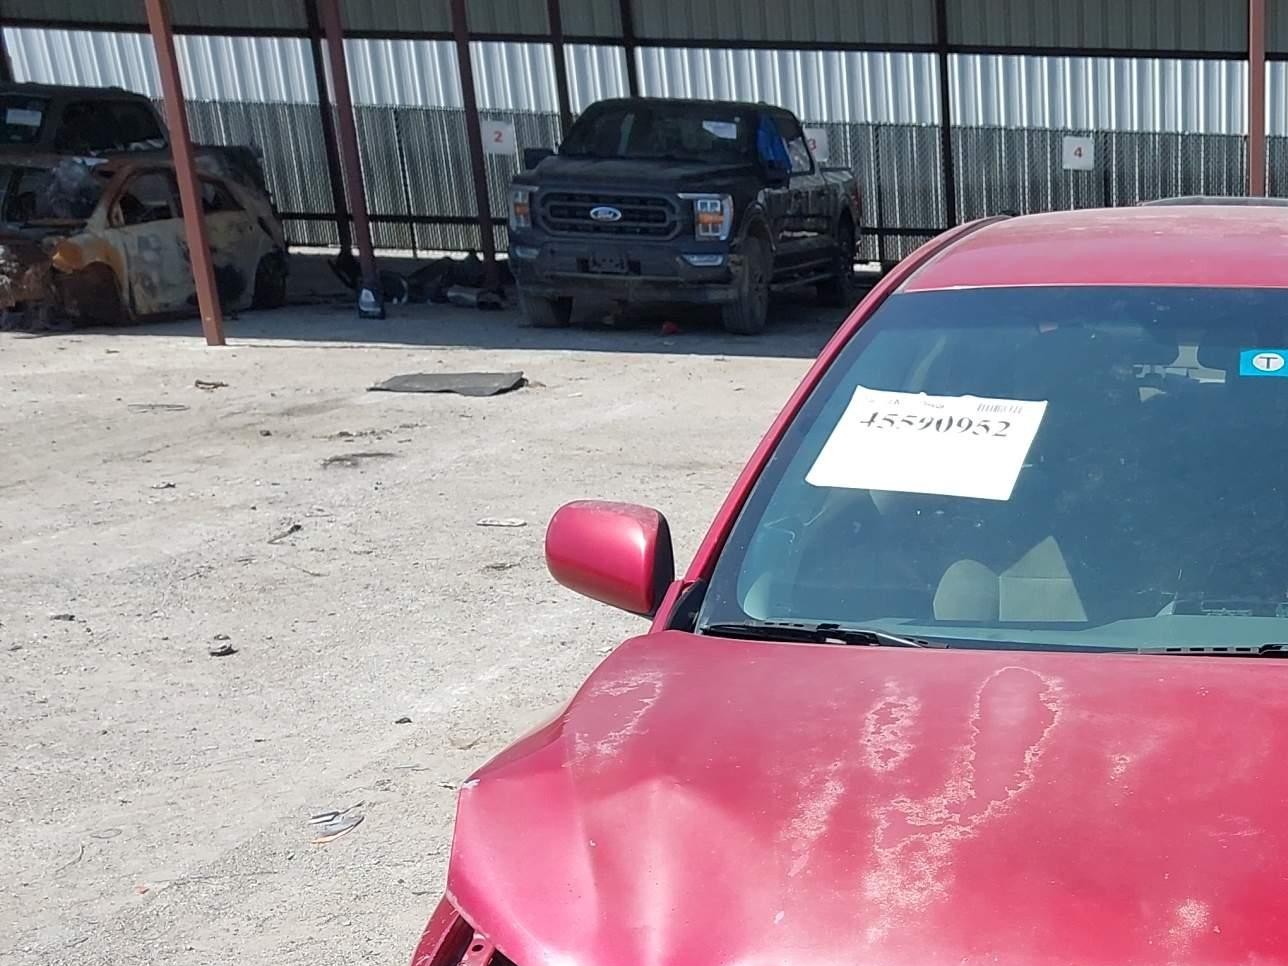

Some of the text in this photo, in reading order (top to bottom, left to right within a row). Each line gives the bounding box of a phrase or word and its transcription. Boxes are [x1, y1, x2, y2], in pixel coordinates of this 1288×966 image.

[493, 130, 504, 143] 2
[1073, 146, 1083, 158] 4
[1258, 356, 1279, 370] T
[859, 411, 1012, 437] 45590952
